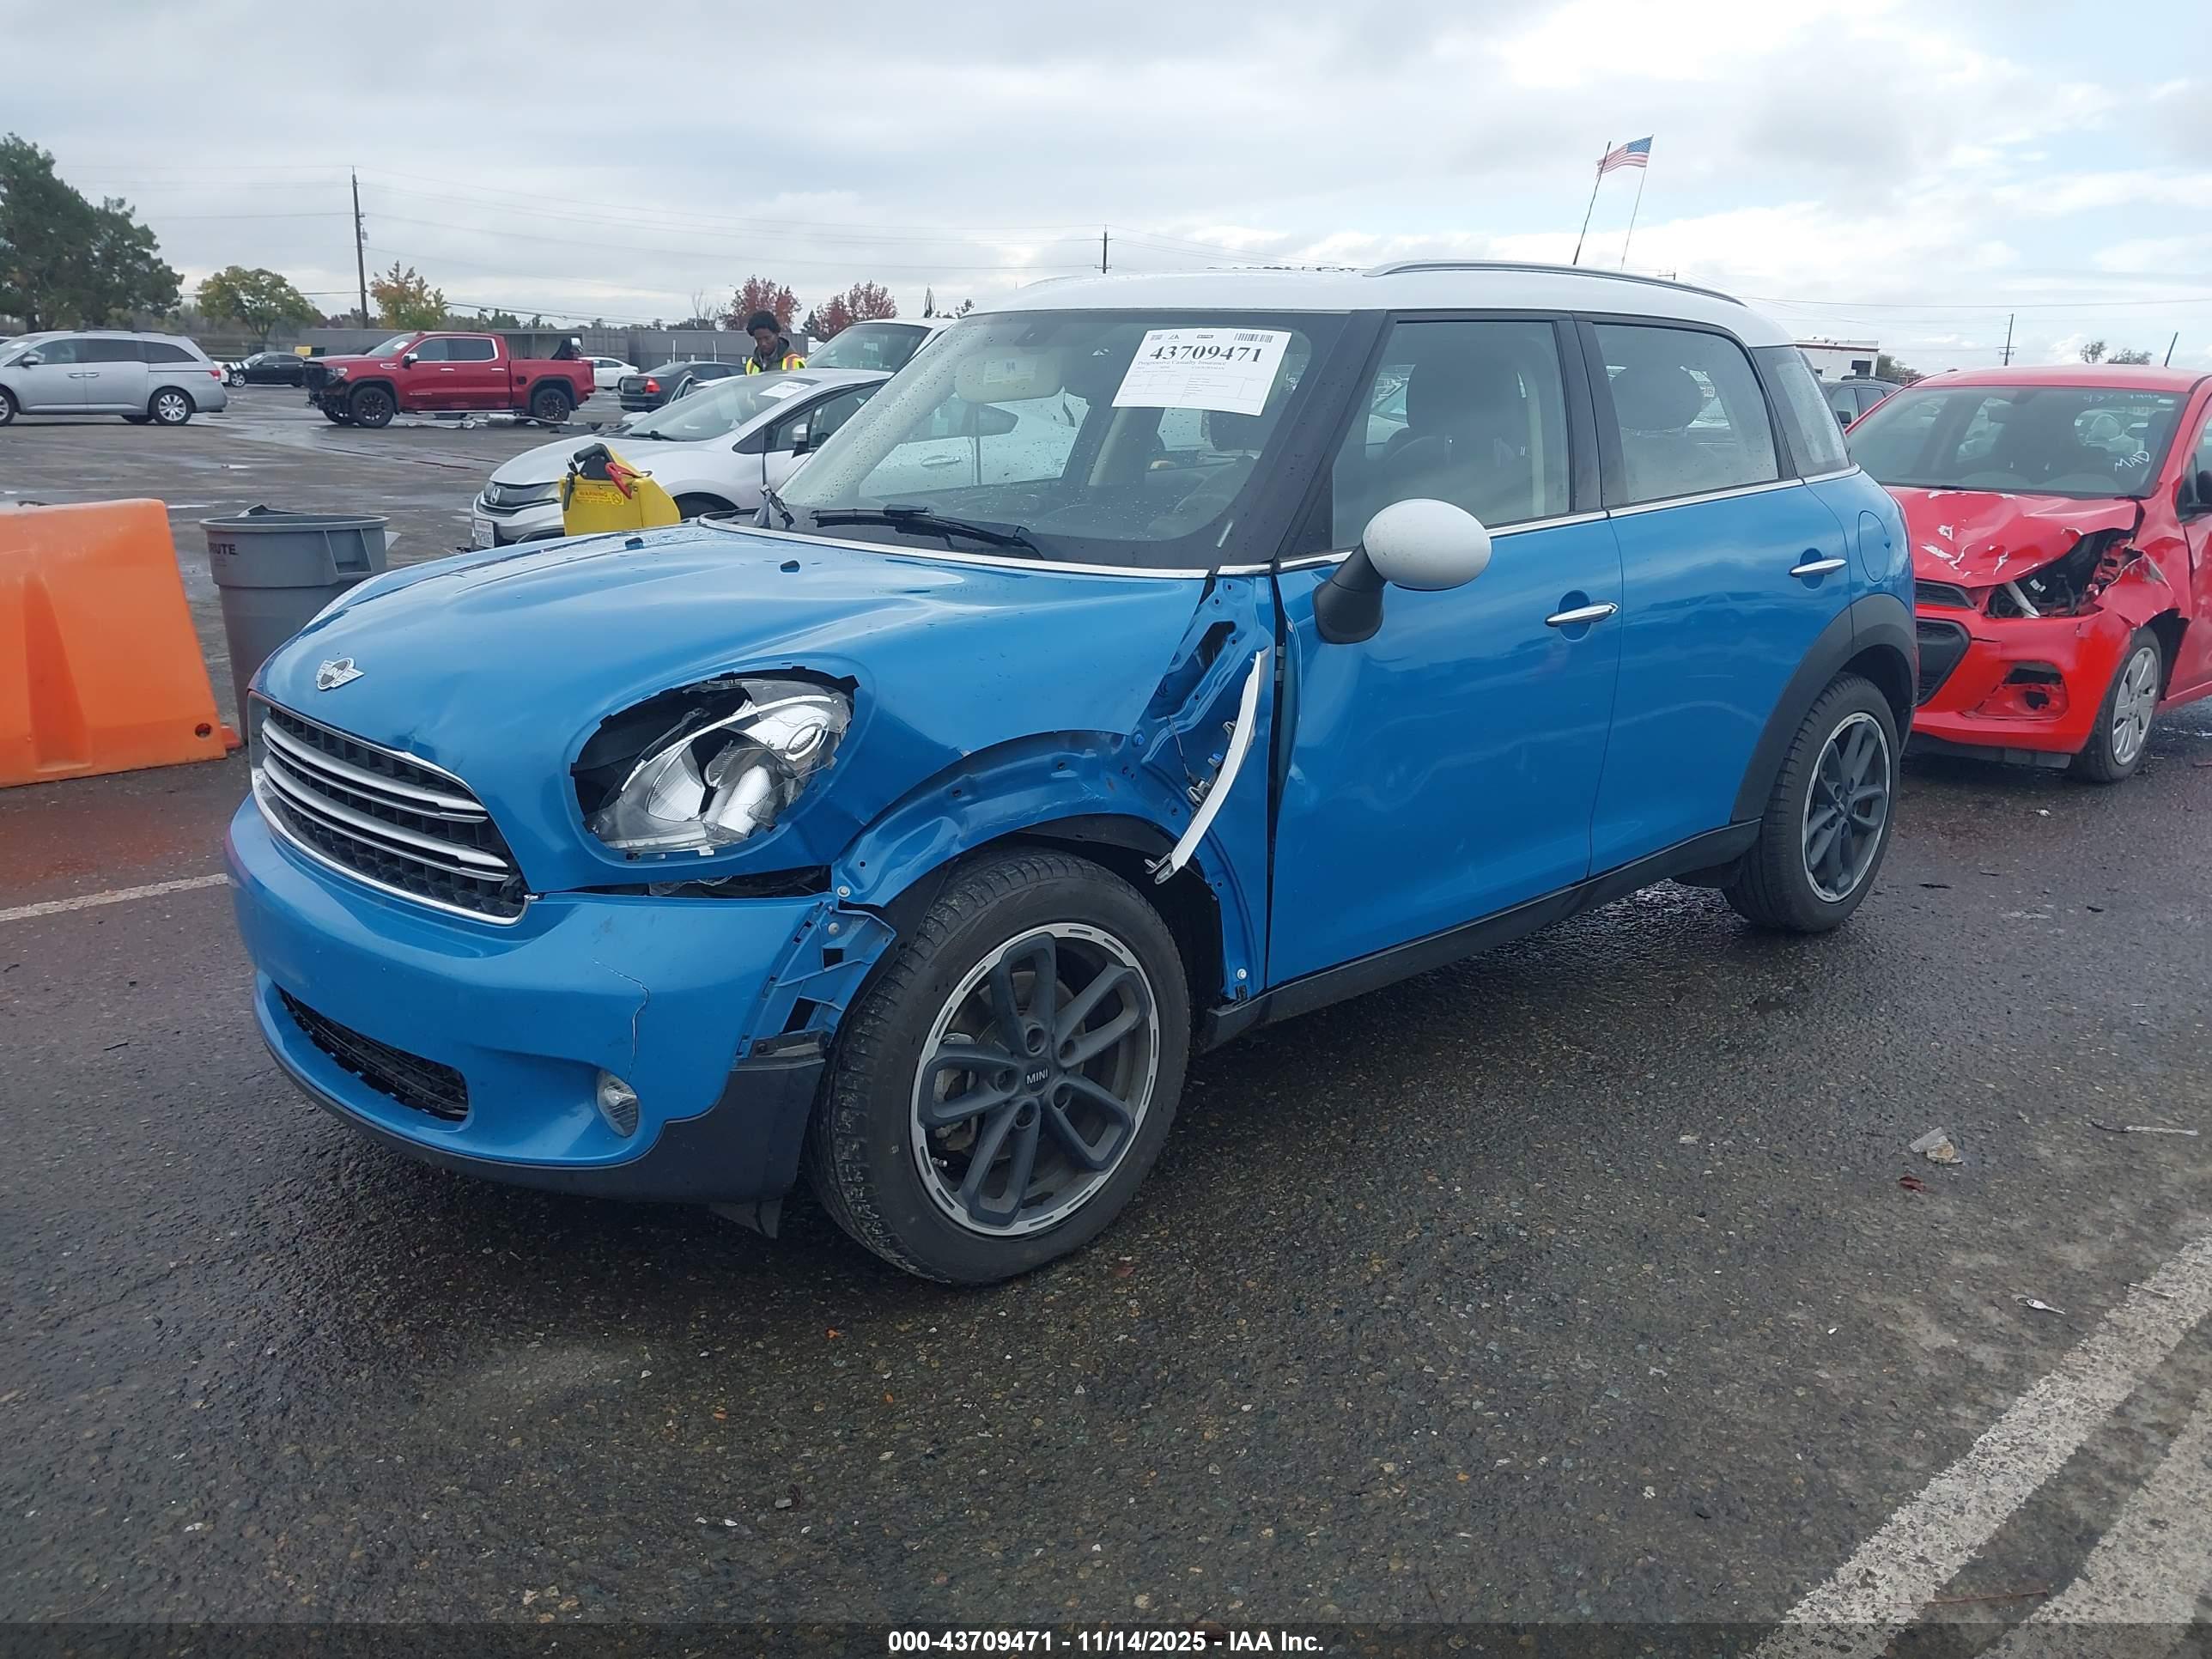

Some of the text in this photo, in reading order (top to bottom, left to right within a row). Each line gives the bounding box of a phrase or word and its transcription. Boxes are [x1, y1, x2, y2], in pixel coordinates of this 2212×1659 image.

[1149, 345, 1263, 362] 43709471
[2114, 451, 2150, 472] MAD
[1026, 1067, 1048, 1085] MINI
